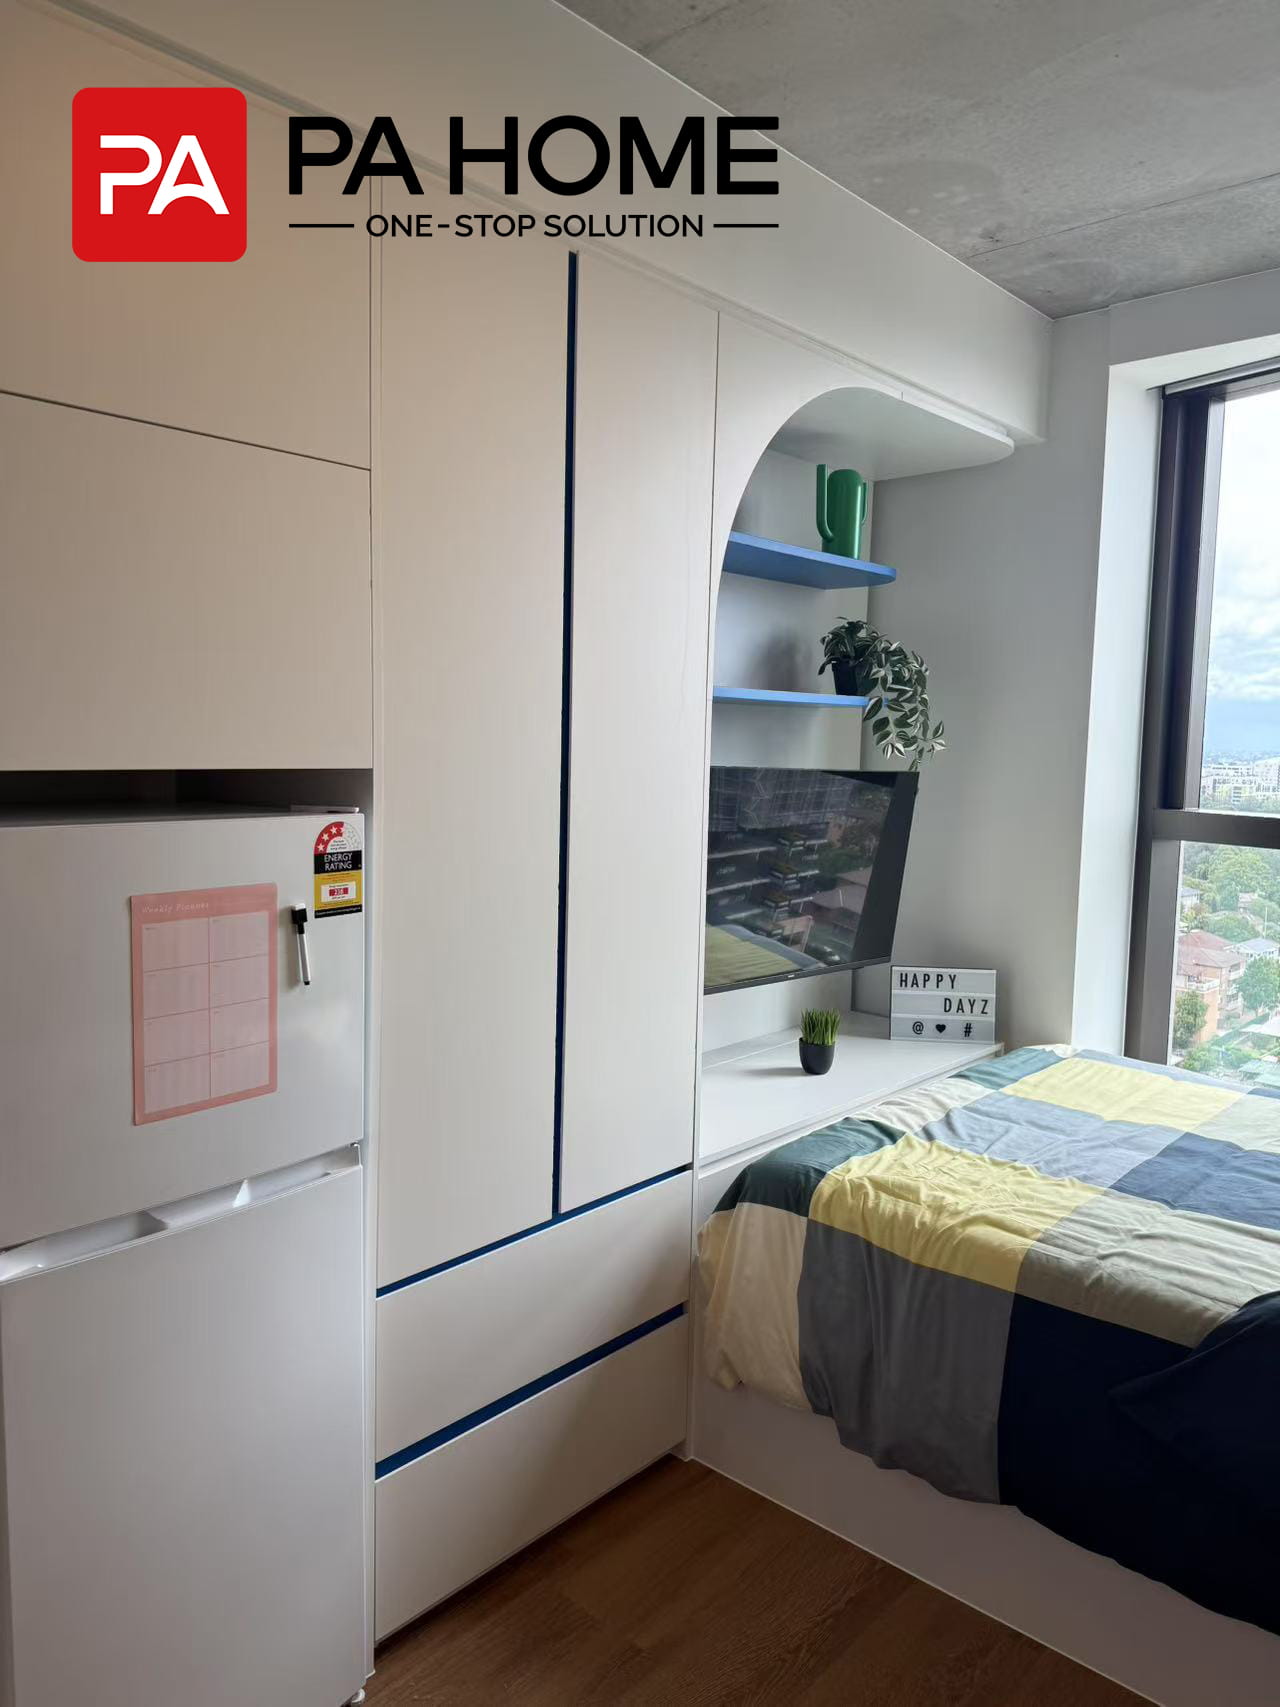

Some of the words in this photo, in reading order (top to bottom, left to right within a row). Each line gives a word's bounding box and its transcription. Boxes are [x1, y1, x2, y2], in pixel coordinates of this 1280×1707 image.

[324, 853, 352, 862] ENERGY
[325, 861, 352, 871] RATING
[900, 972, 957, 989] HAPPY
[943, 997, 988, 1014] DAYZ
